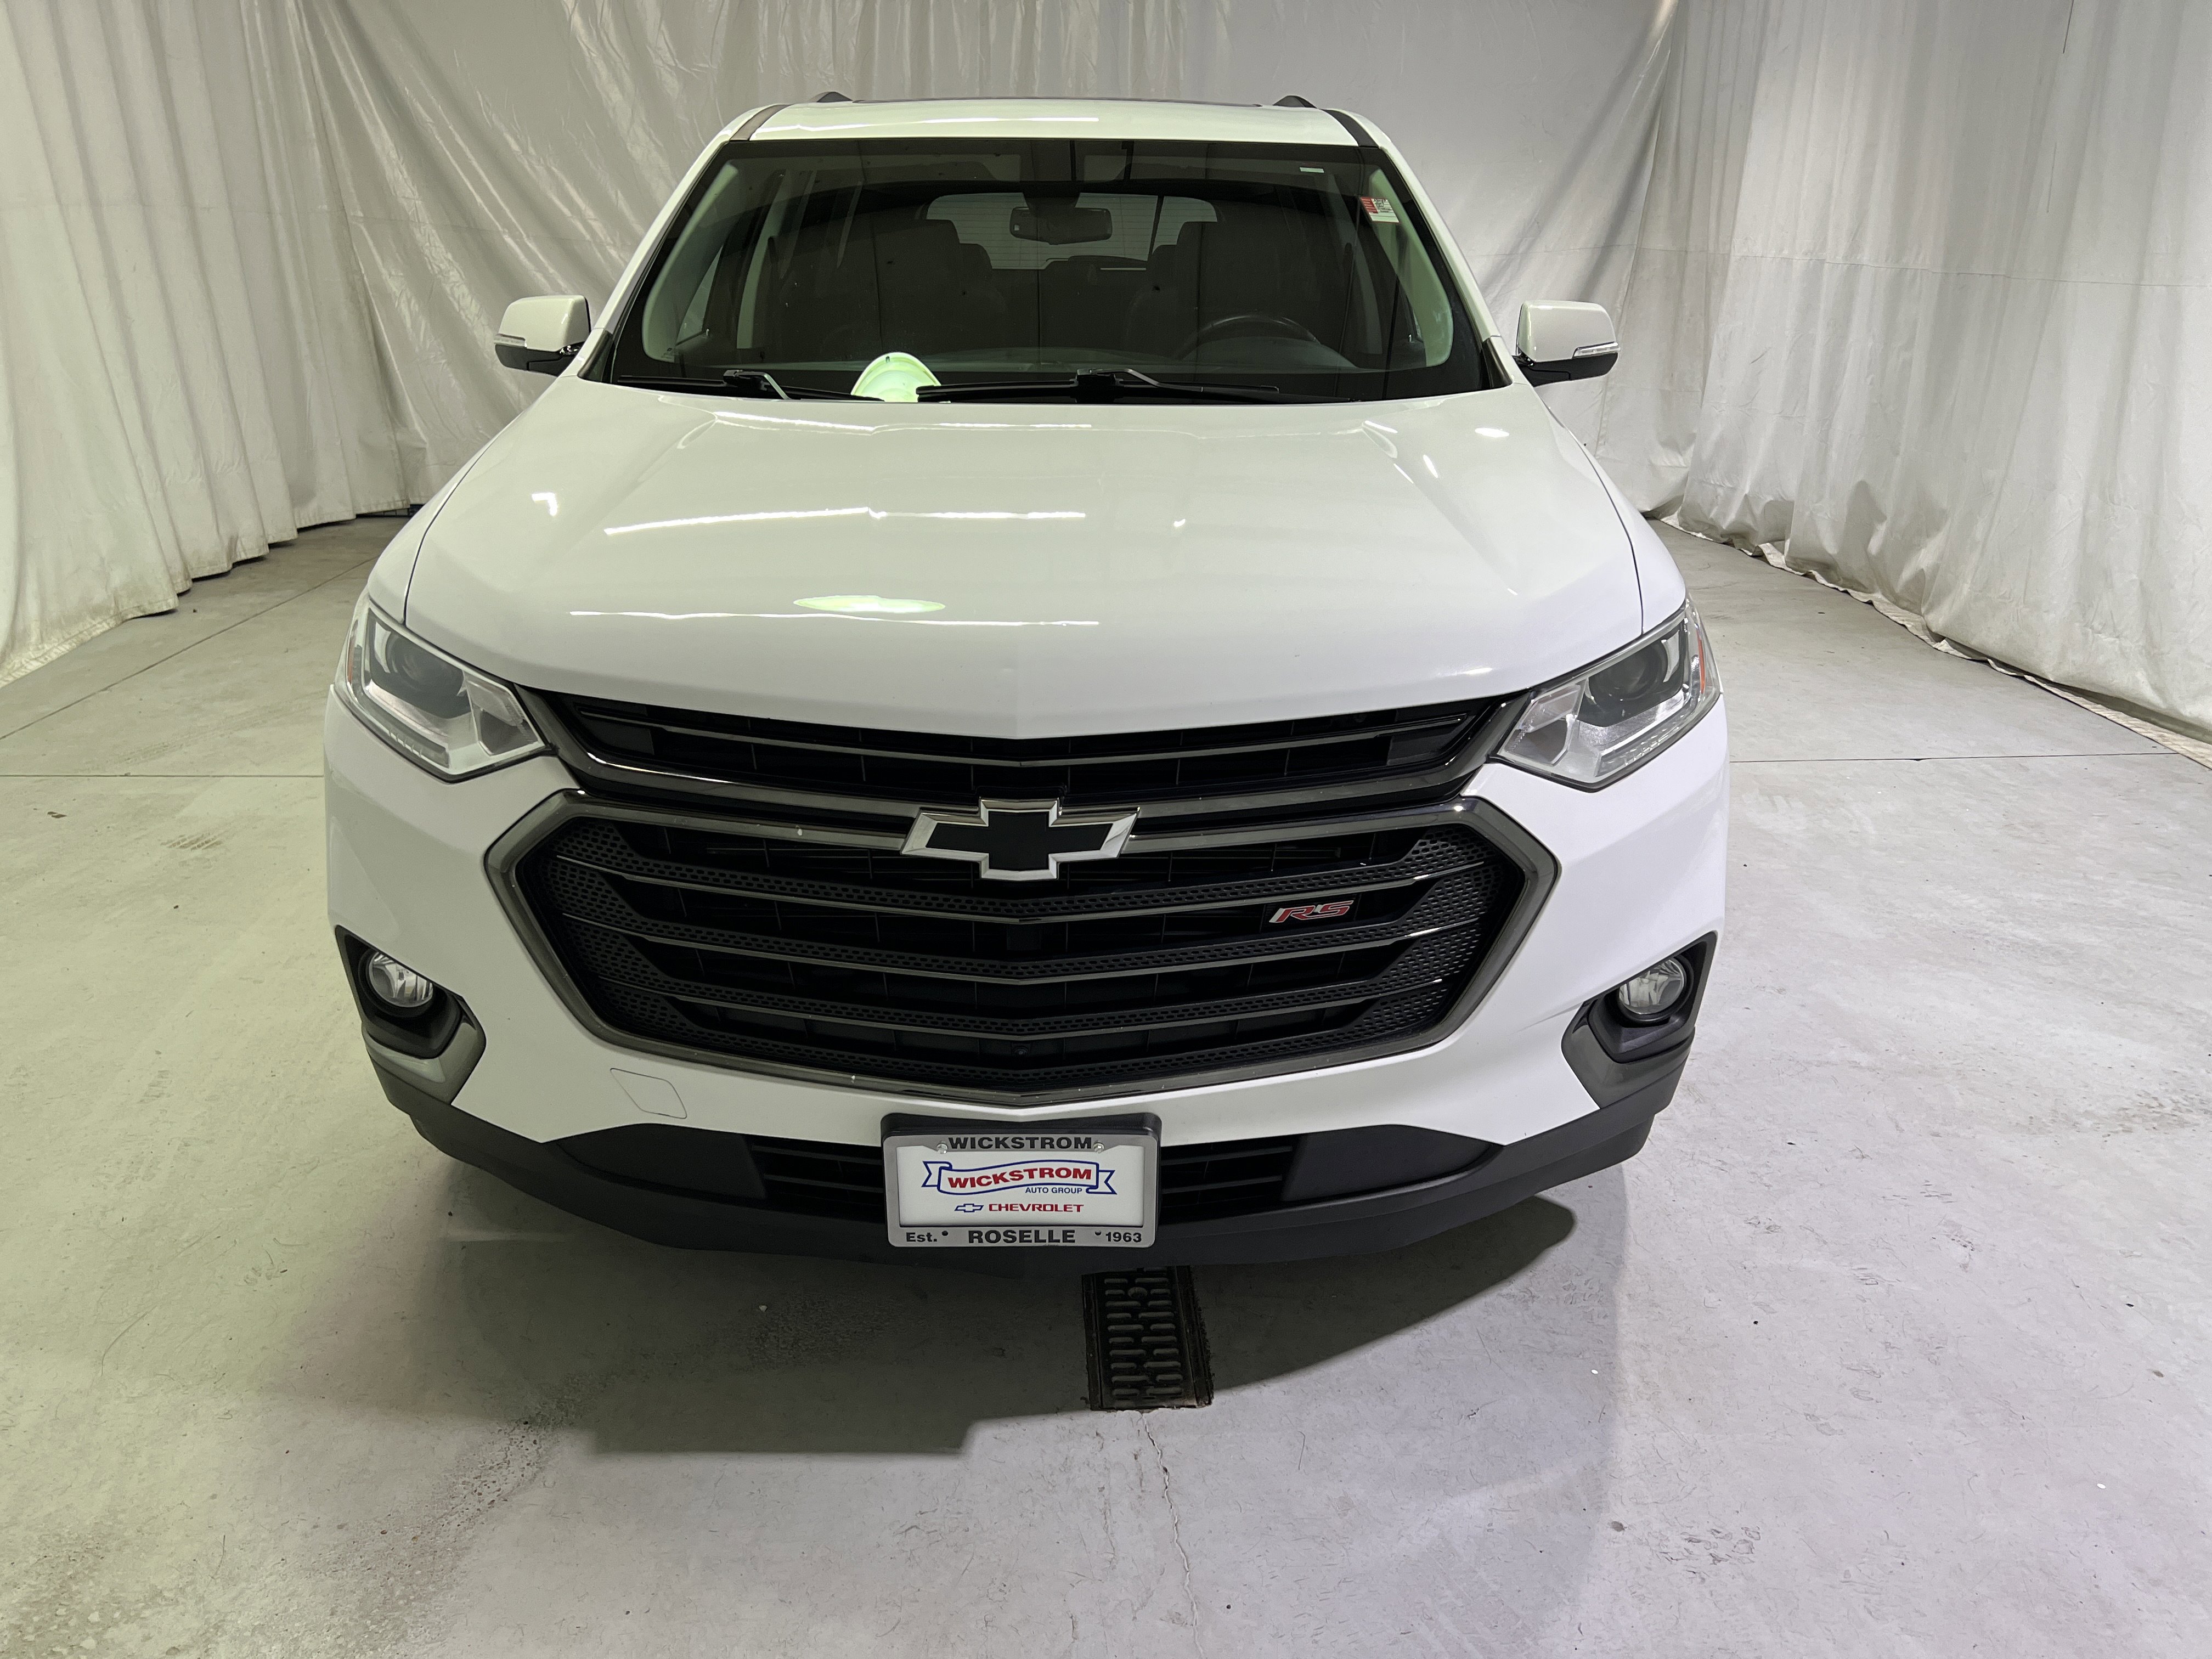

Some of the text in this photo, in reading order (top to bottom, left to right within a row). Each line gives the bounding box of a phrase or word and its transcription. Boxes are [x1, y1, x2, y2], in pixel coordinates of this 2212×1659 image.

[1269, 900, 1354, 923] RS
[948, 1137, 1092, 1149] WICKSTROM
[948, 1167, 1092, 1188] WICKSTROM
[989, 1204, 1084, 1212] CHEVROLET
[906, 1230, 1142, 1243] Est. ROSELLE 1963
